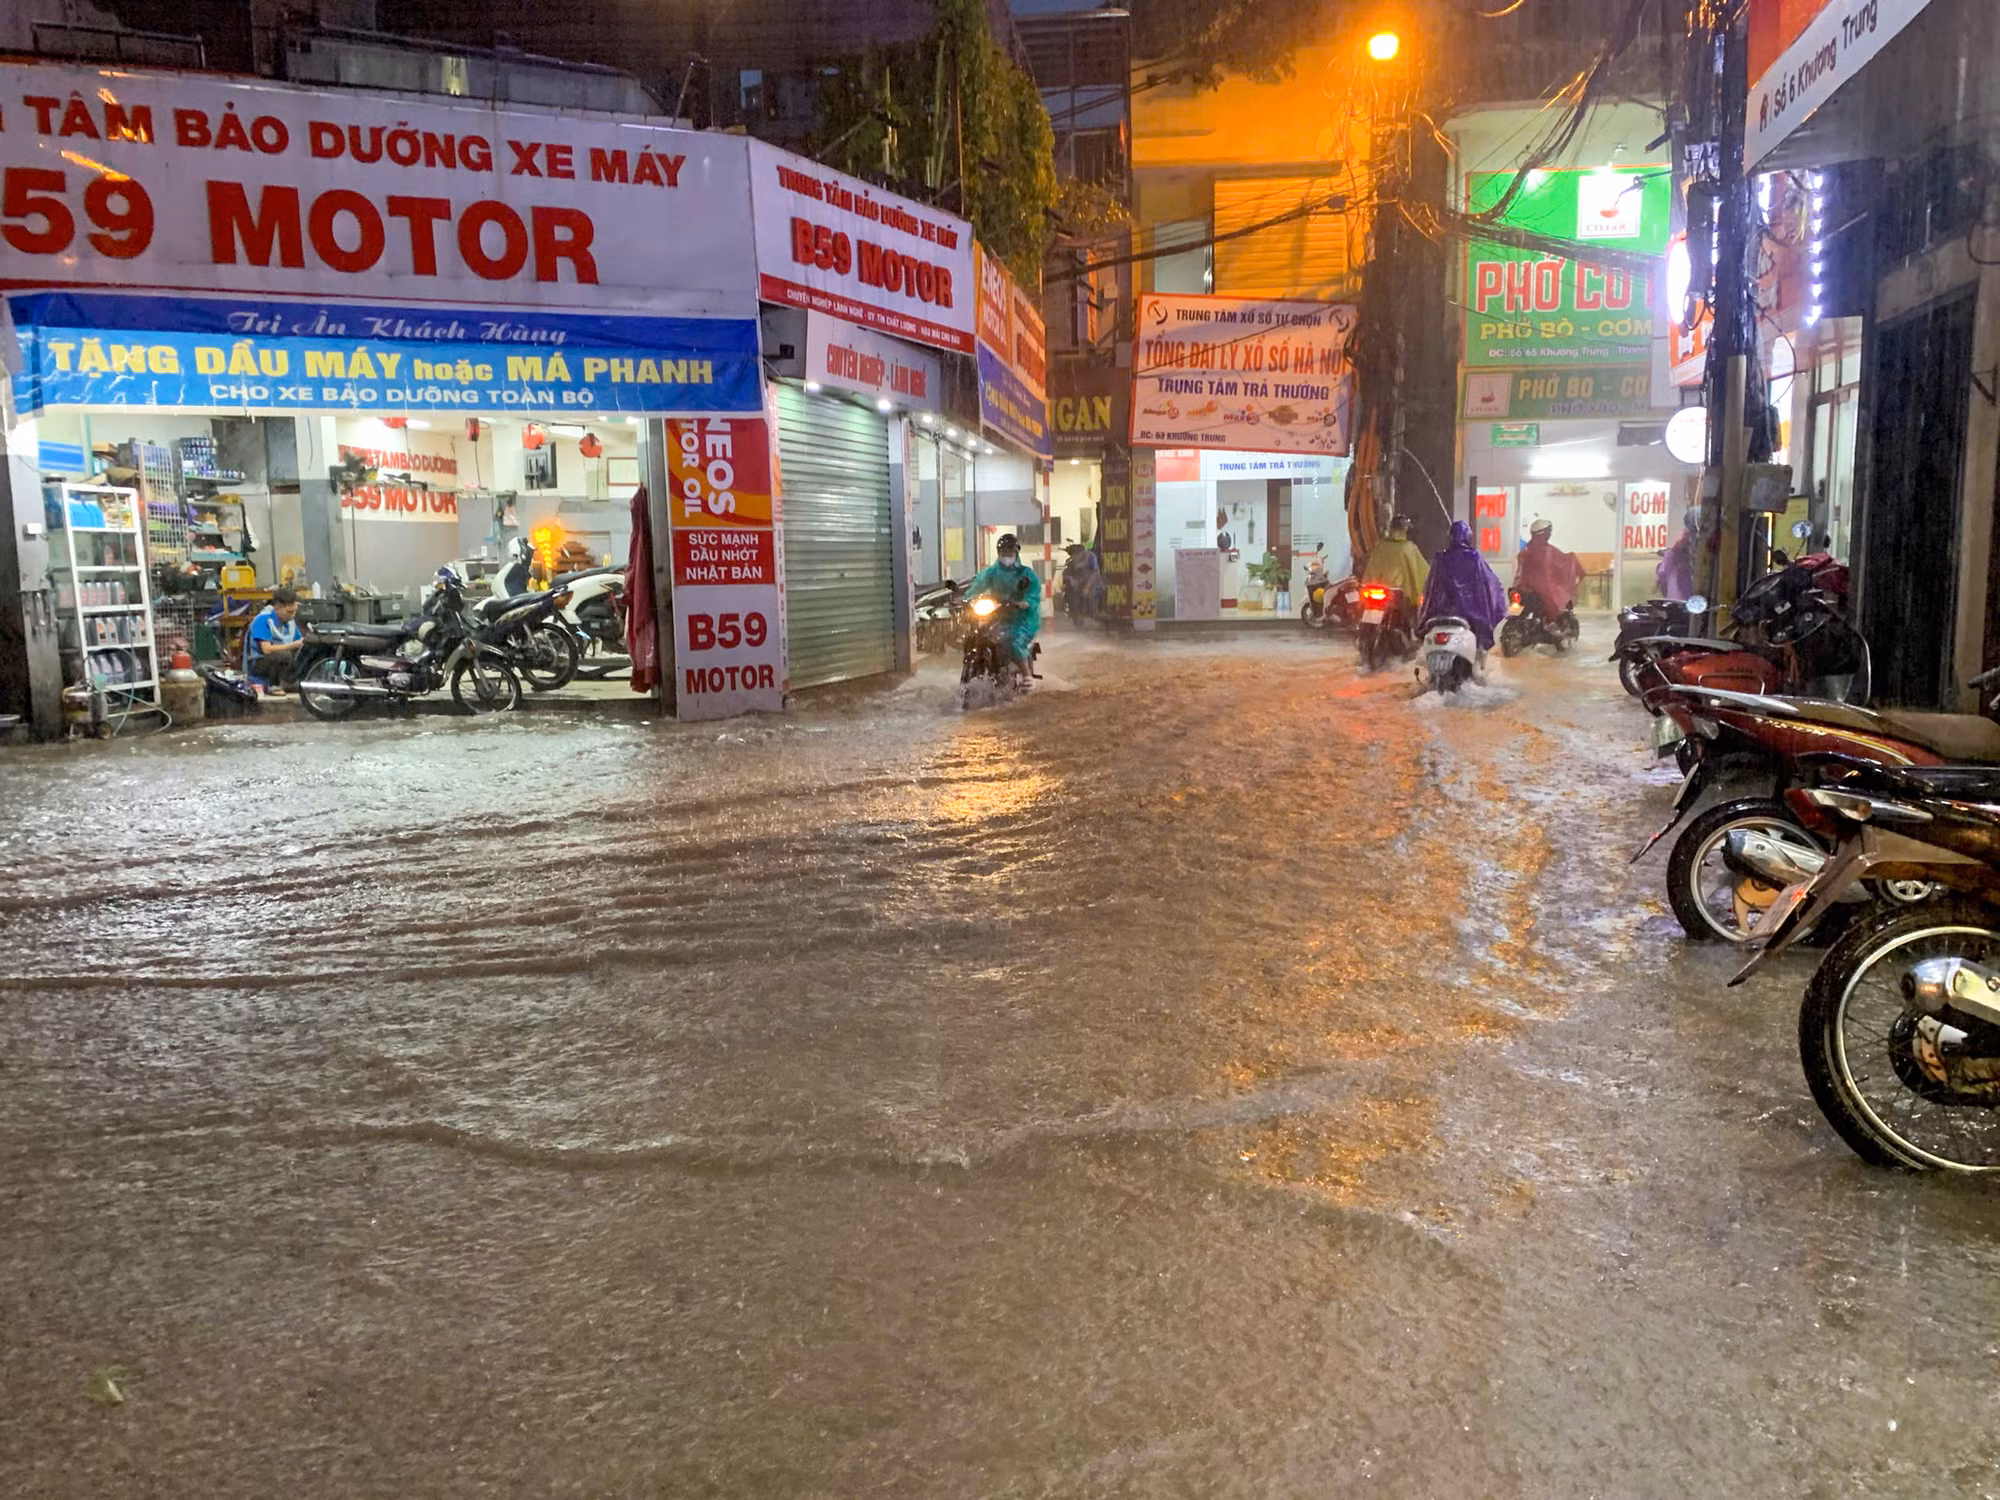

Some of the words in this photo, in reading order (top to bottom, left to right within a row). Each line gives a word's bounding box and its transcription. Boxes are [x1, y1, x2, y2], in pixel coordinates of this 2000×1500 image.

[1789, 74, 1795, 103] 6
[1798, 36, 1837, 96] Khương
[1842, 0, 1877, 50] Trung
[23, 90, 155, 145] TÂM
[173, 101, 290, 154] BẢO
[308, 119, 493, 172] DƯỠNG
[507, 140, 576, 181] XE
[588, 143, 686, 188] MÁY
[776, 164, 823, 201] TRUNG
[823, 180, 853, 212] TÂM
[854, 189, 880, 222] BẢO
[920, 219, 936, 242] XE
[206, 179, 599, 285] MOTOR
[791, 216, 852, 276] B59
[856, 239, 953, 309] MOTOR
[1476, 250, 1567, 313] PHỞ
[1176, 308, 1211, 322] TRUNG
[1214, 309, 1237, 323] TÂM
[1480, 317, 1533, 340] PHỞ
[362, 316, 466, 340] Khách
[479, 320, 568, 345] Hàng
[47, 337, 181, 378] TẶNG
[304, 345, 402, 380] MÁY
[413, 357, 493, 386] hoặc
[506, 350, 572, 383] MÁ
[584, 356, 714, 385] PHANH
[1144, 329, 1186, 369] TỔNG
[1189, 341, 1217, 376] ĐẠI
[1243, 334, 1267, 373] XỔ
[1268, 335, 1291, 373] SỐ
[1293, 340, 1315, 376] HÀ
[210, 384, 269, 401] CHO
[278, 386, 313, 402] XE
[322, 381, 378, 402] BẢO
[386, 385, 480, 404] DƯỠNG
[562, 387, 595, 409] BỘ
[1157, 378, 1204, 395] TRUNG
[1208, 378, 1238, 396] TÂM
[1243, 378, 1269, 399] TRẢ
[1273, 380, 1330, 401] THƯỞNG
[1517, 373, 1560, 401] PHỞ
[1201, 433, 1226, 444] TRUNG
[1219, 462, 1247, 471] TRUNG
[682, 477, 702, 519] OIL
[688, 531, 718, 546] SỨC
[721, 533, 759, 548] MẠNH
[1623, 524, 1668, 549] RANG
[690, 545, 718, 561] DẦU
[721, 546, 759, 561] NHỚT
[686, 563, 728, 582] NHẬT
[731, 562, 763, 580] BẢN
[687, 610, 768, 652] B59
[685, 663, 775, 695] MOTOR
